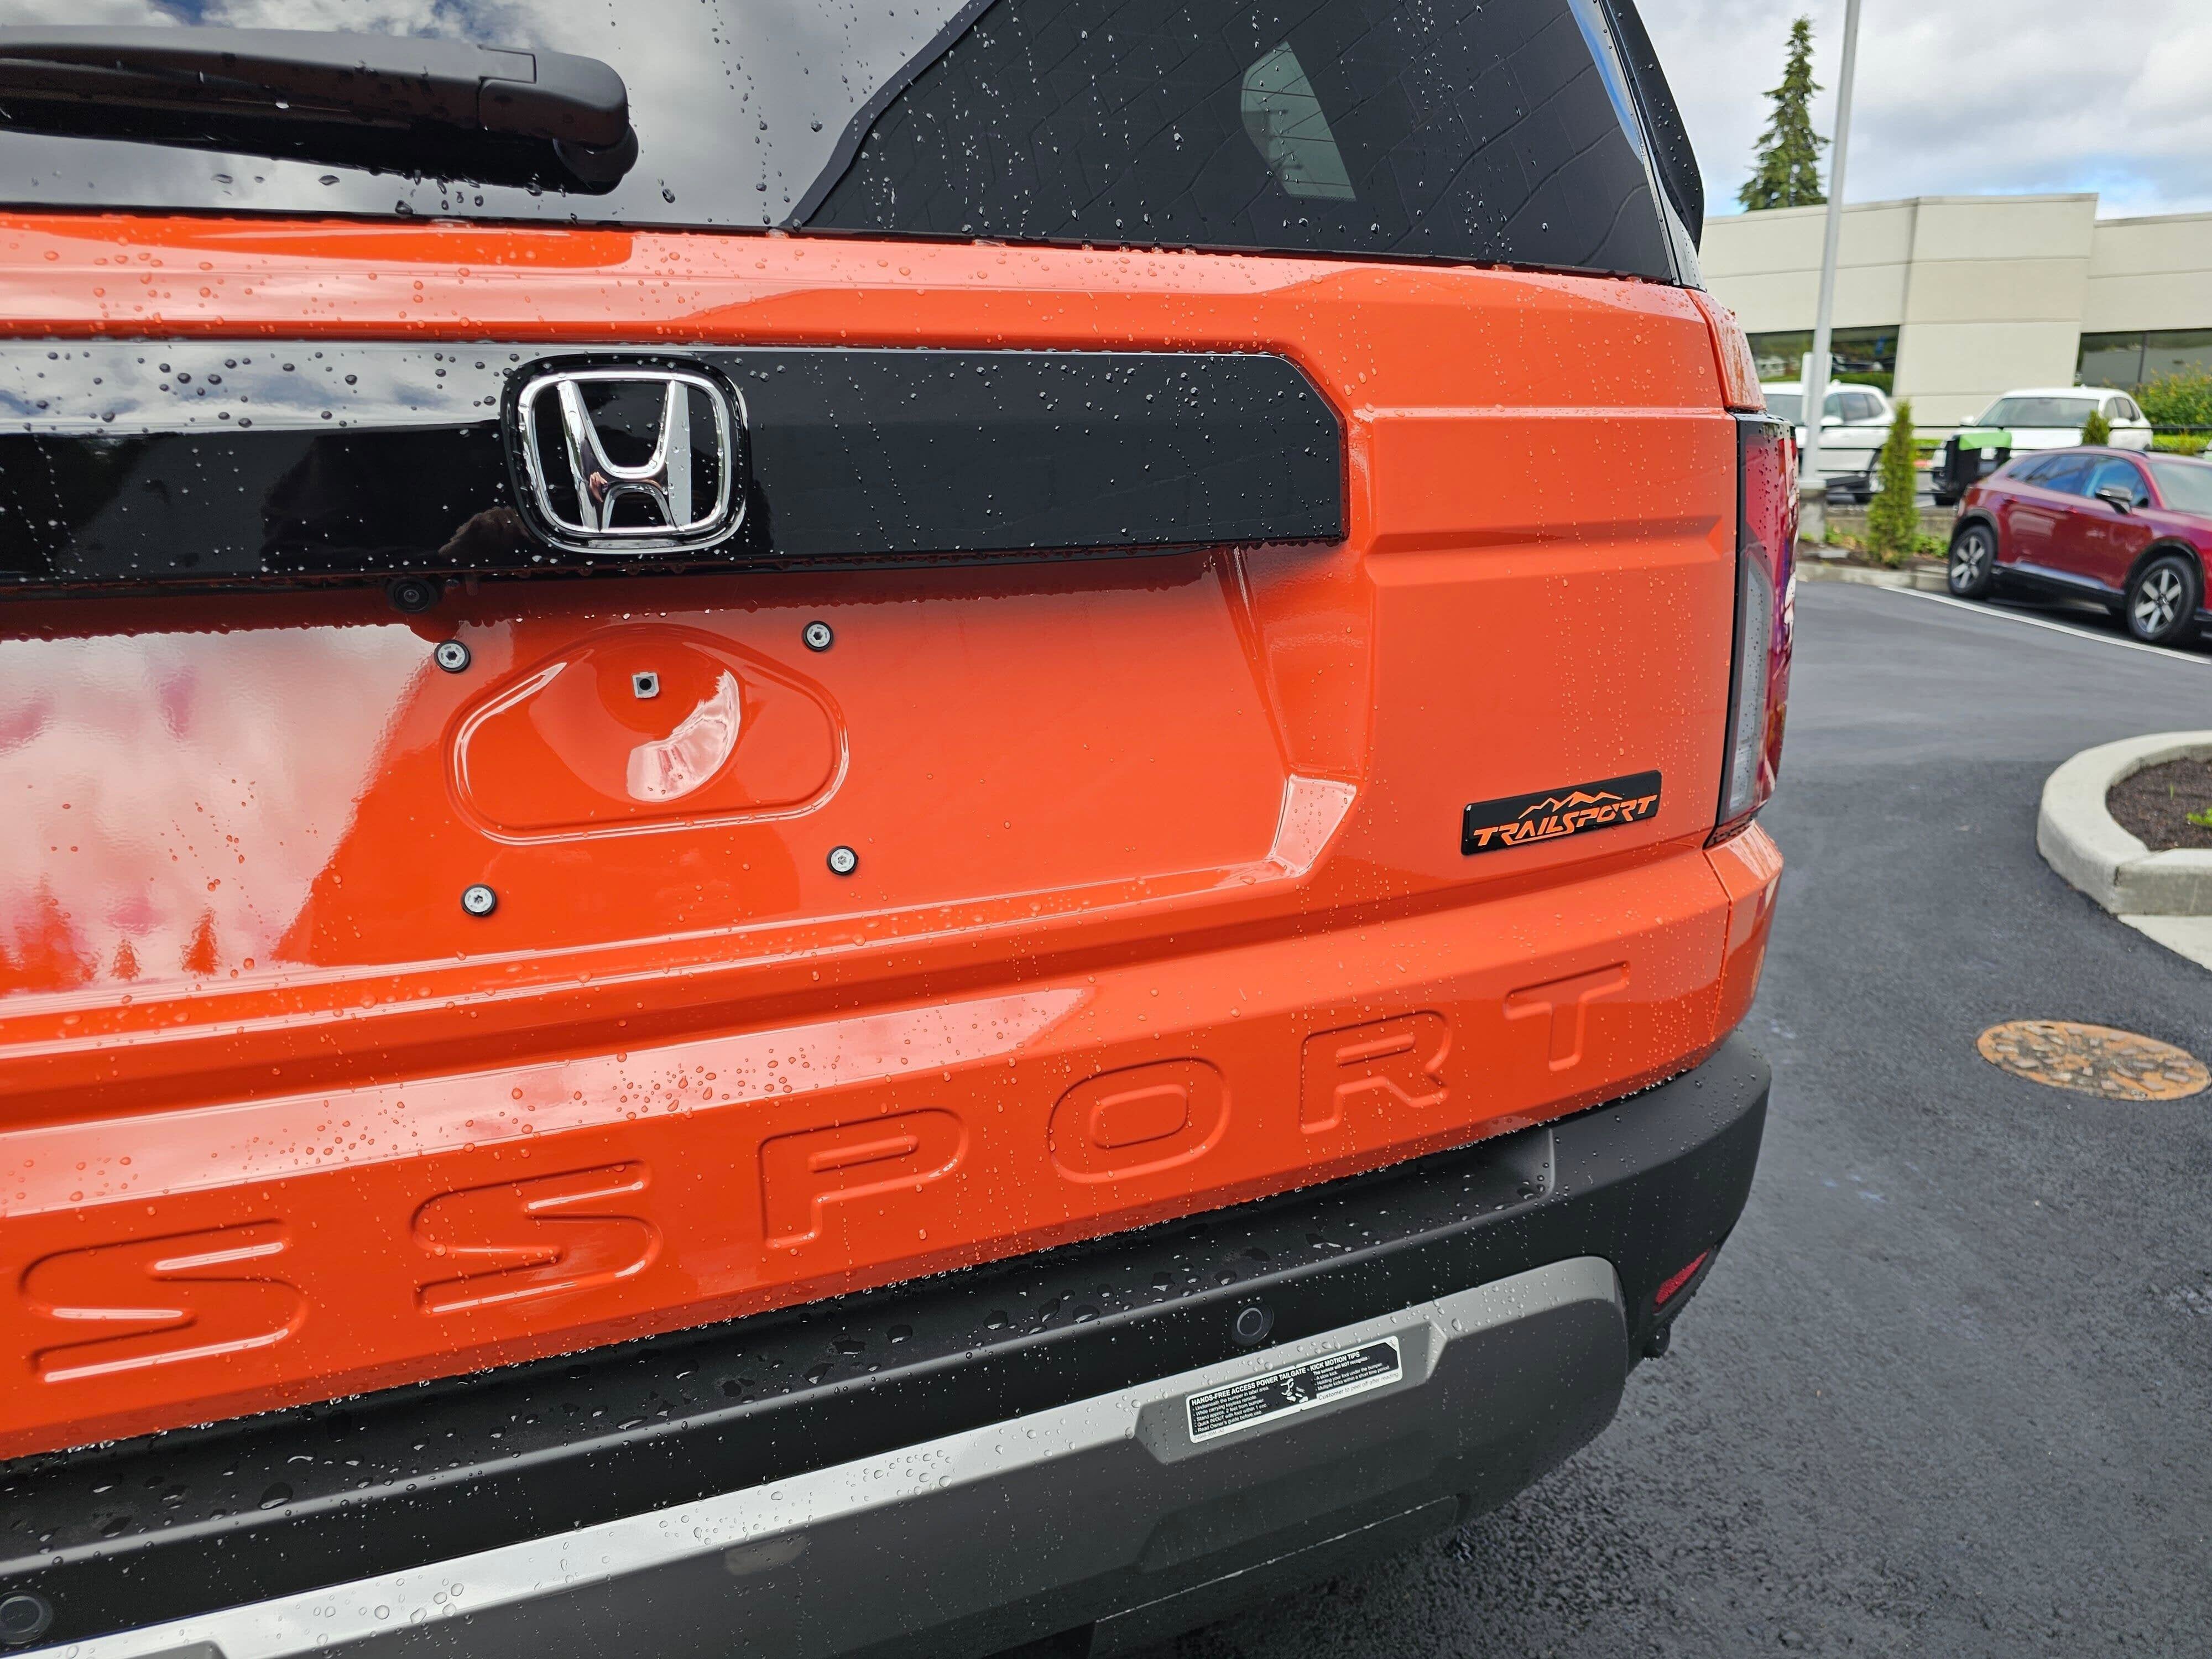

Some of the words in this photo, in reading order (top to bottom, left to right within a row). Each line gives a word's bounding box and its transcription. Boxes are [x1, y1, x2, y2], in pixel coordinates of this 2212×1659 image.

[1473, 795, 1657, 846] TRAILSPORT
[1192, 1390, 1230, 1405] HANDS-FREE
[1231, 1383, 1255, 1394] ACCESS
[1256, 1376, 1278, 1387] POWER
[1278, 1368, 1306, 1380] TAILGATE
[1310, 1362, 1324, 1371] KICK
[1324, 1355, 1347, 1366] MOTION
[1319, 1389, 1343, 1400] Customer
[1208, 1405, 1225, 1413] carrying
